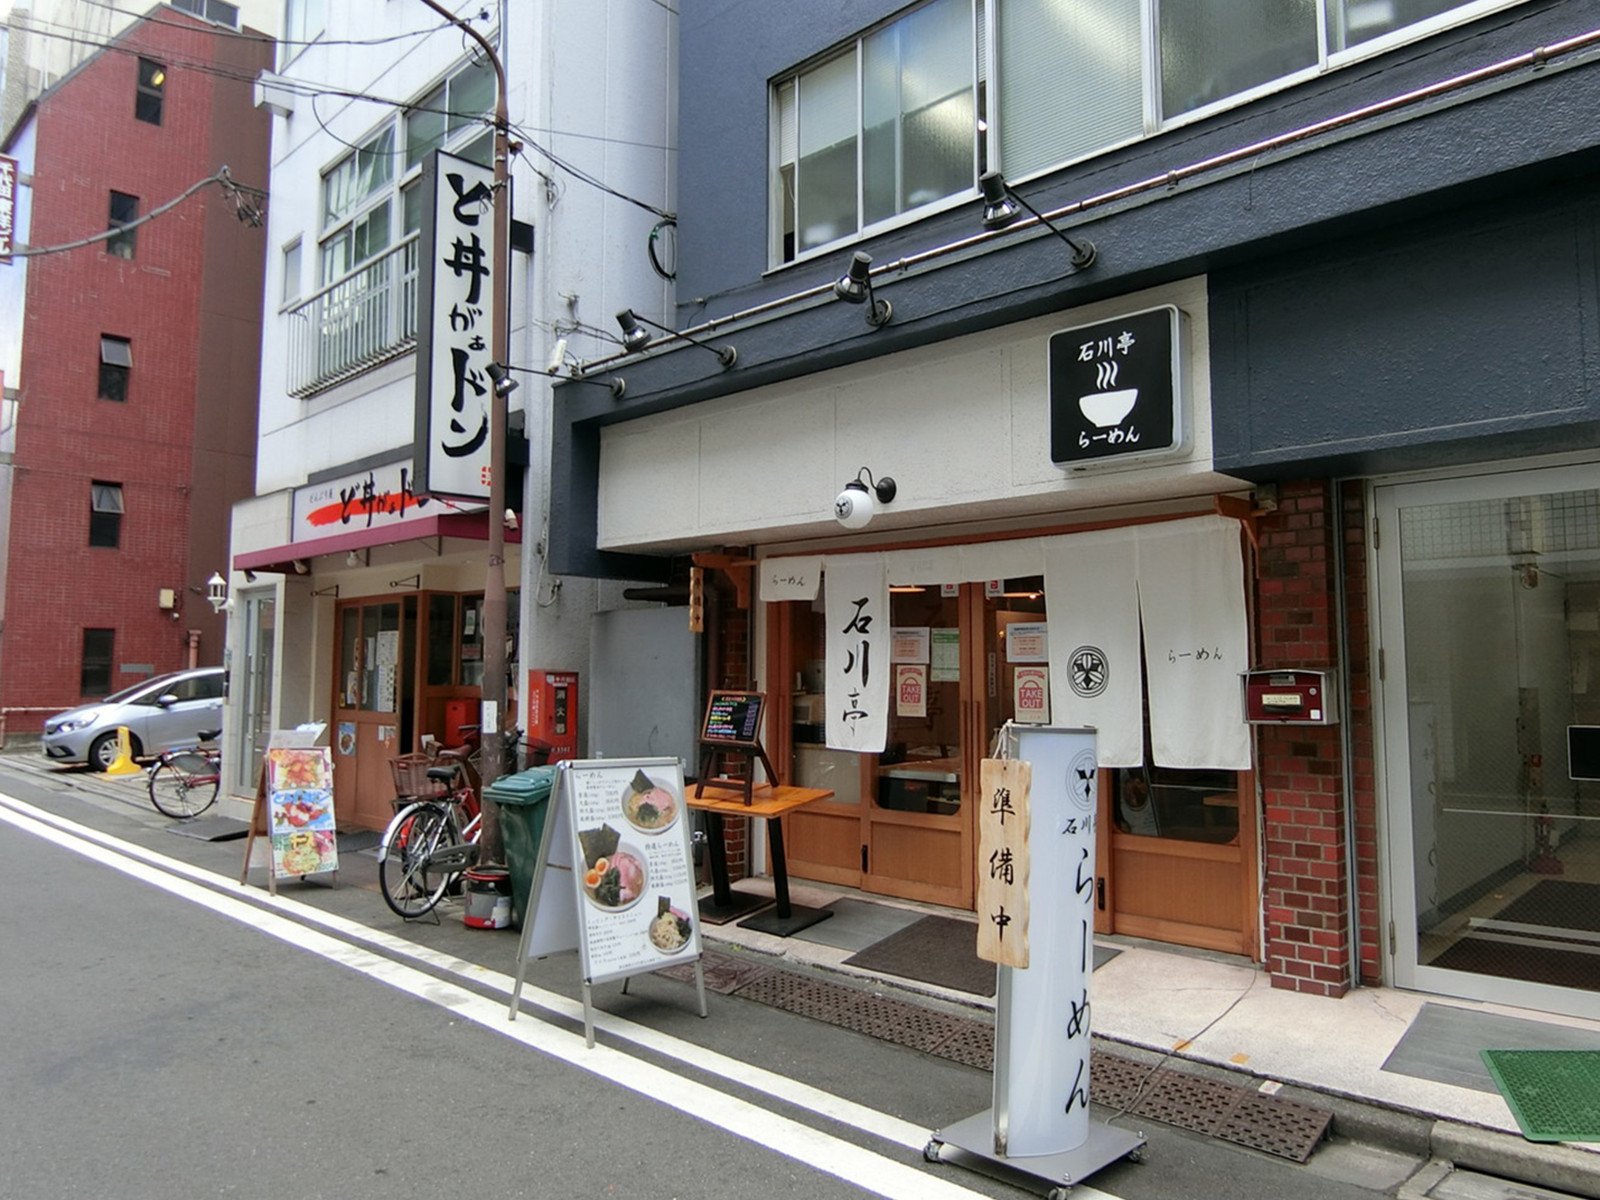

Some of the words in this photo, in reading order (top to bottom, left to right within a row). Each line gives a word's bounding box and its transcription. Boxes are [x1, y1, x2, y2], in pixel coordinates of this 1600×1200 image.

[1077, 331, 1136, 362] 石川亭
[1078, 426, 1141, 449] らーめん
[772, 574, 806, 587] らーめん
[1168, 646, 1223, 664] らーめん
[842, 596, 873, 737] 石川亭
[902, 684, 921, 694] TAKE
[1020, 689, 1044, 699] TAKE
[902, 694, 919, 703] OUT
[1021, 699, 1042, 709] OUT
[989, 787, 1016, 943] 準備中
[1065, 847, 1093, 1115] らーめん
